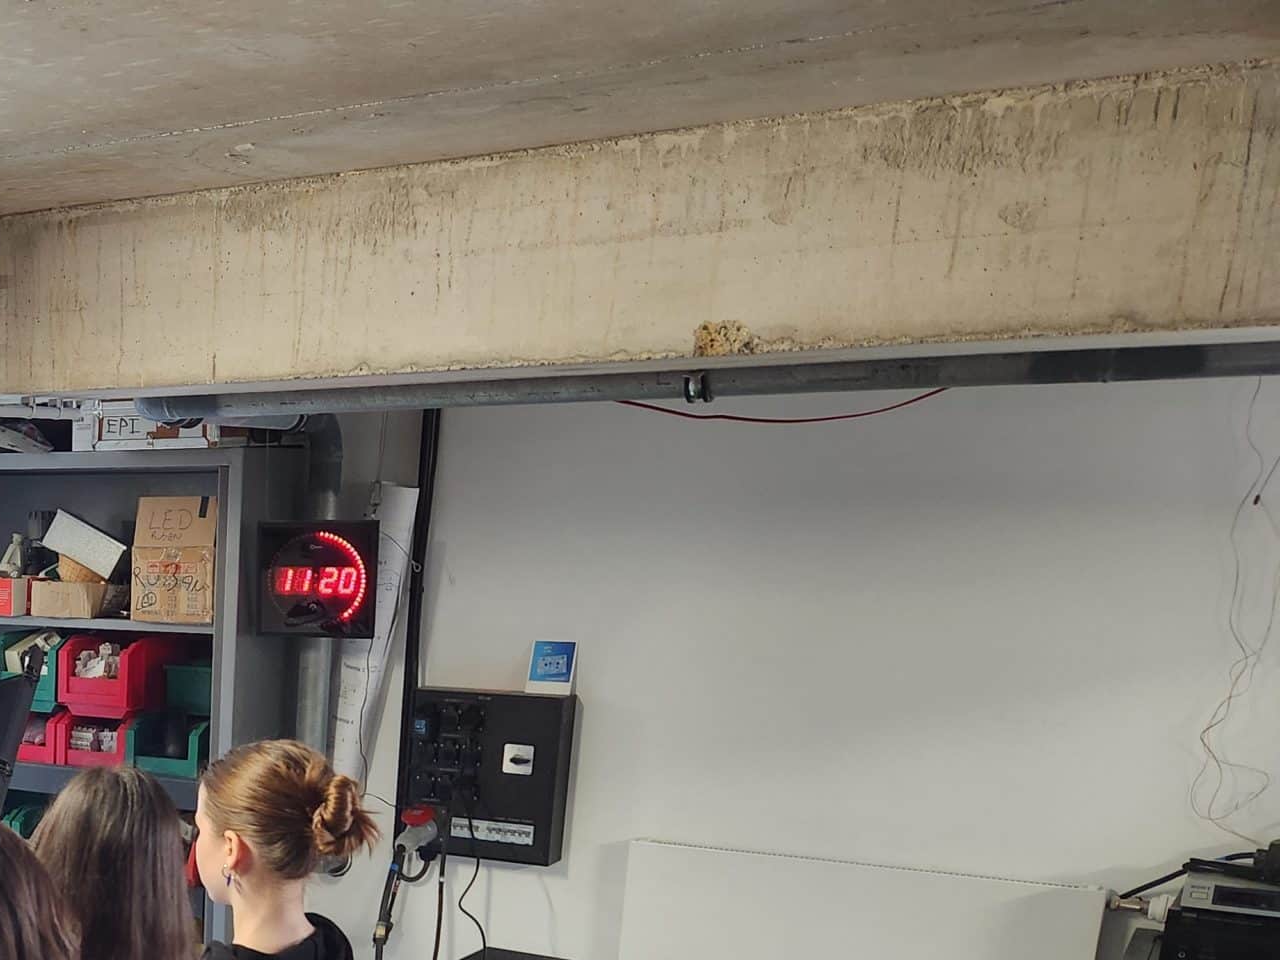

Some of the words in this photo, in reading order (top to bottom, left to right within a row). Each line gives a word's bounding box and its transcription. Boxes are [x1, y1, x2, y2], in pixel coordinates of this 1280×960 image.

[106, 417, 141, 436] EPI
[148, 508, 194, 531] LED
[282, 566, 358, 595] 11:20
